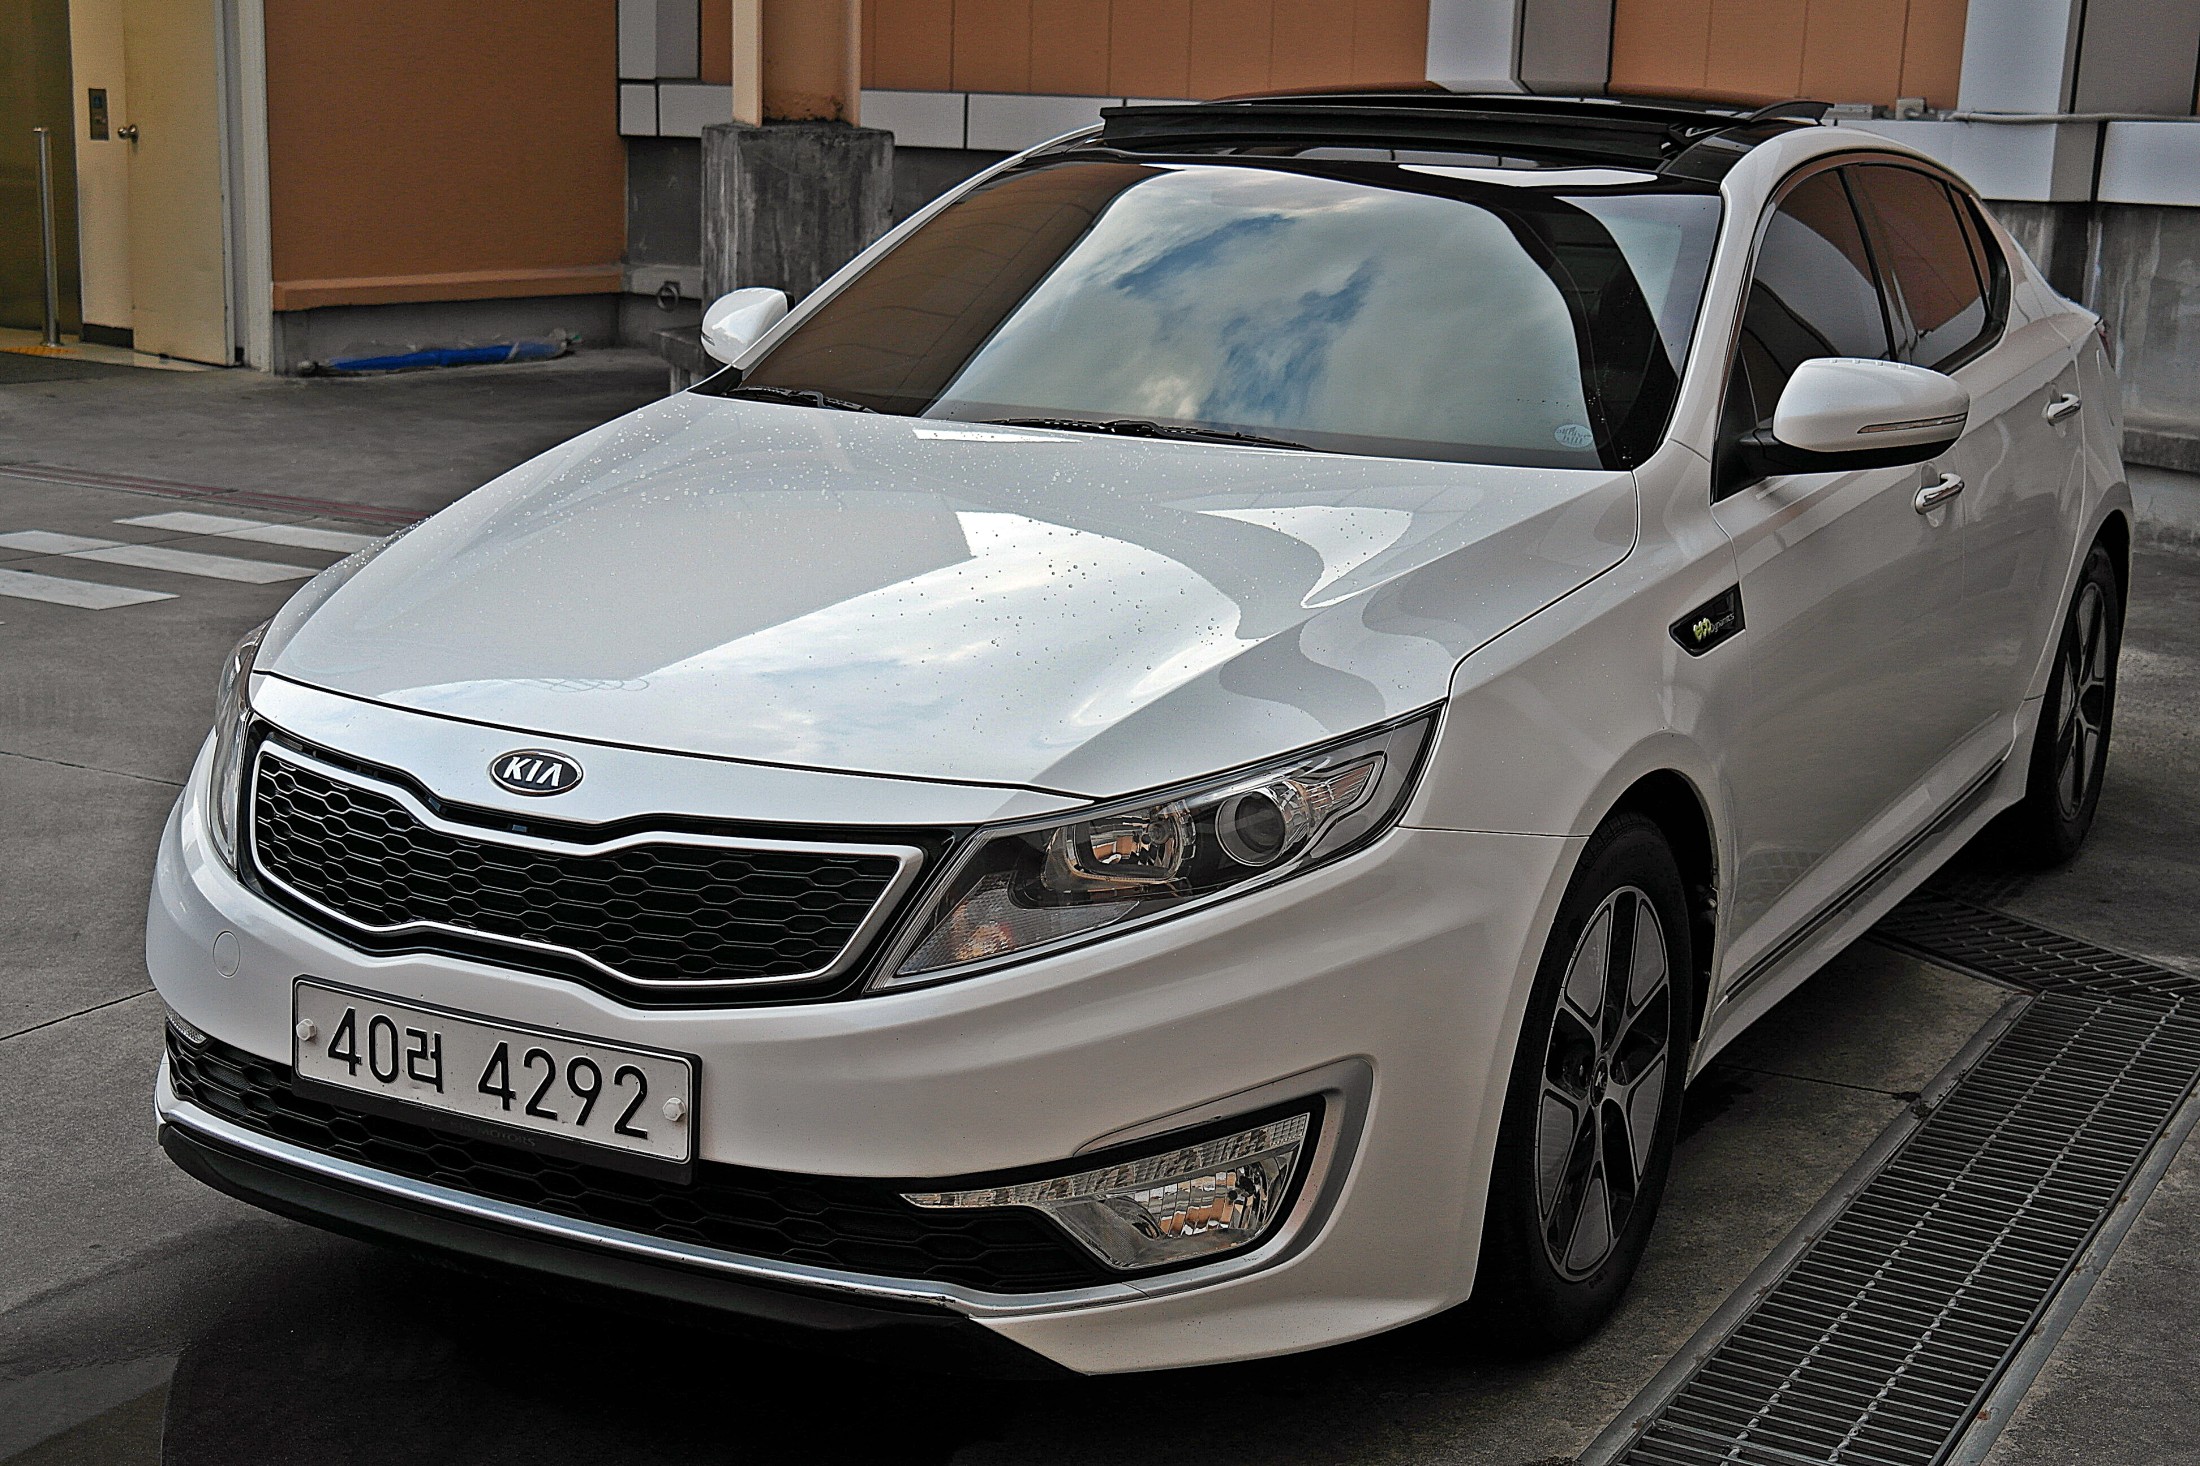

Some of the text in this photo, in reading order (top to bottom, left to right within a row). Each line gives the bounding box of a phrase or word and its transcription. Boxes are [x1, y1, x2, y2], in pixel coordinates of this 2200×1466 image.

[503, 757, 562, 787] KIA
[328, 1007, 648, 1140] 40러 4292
